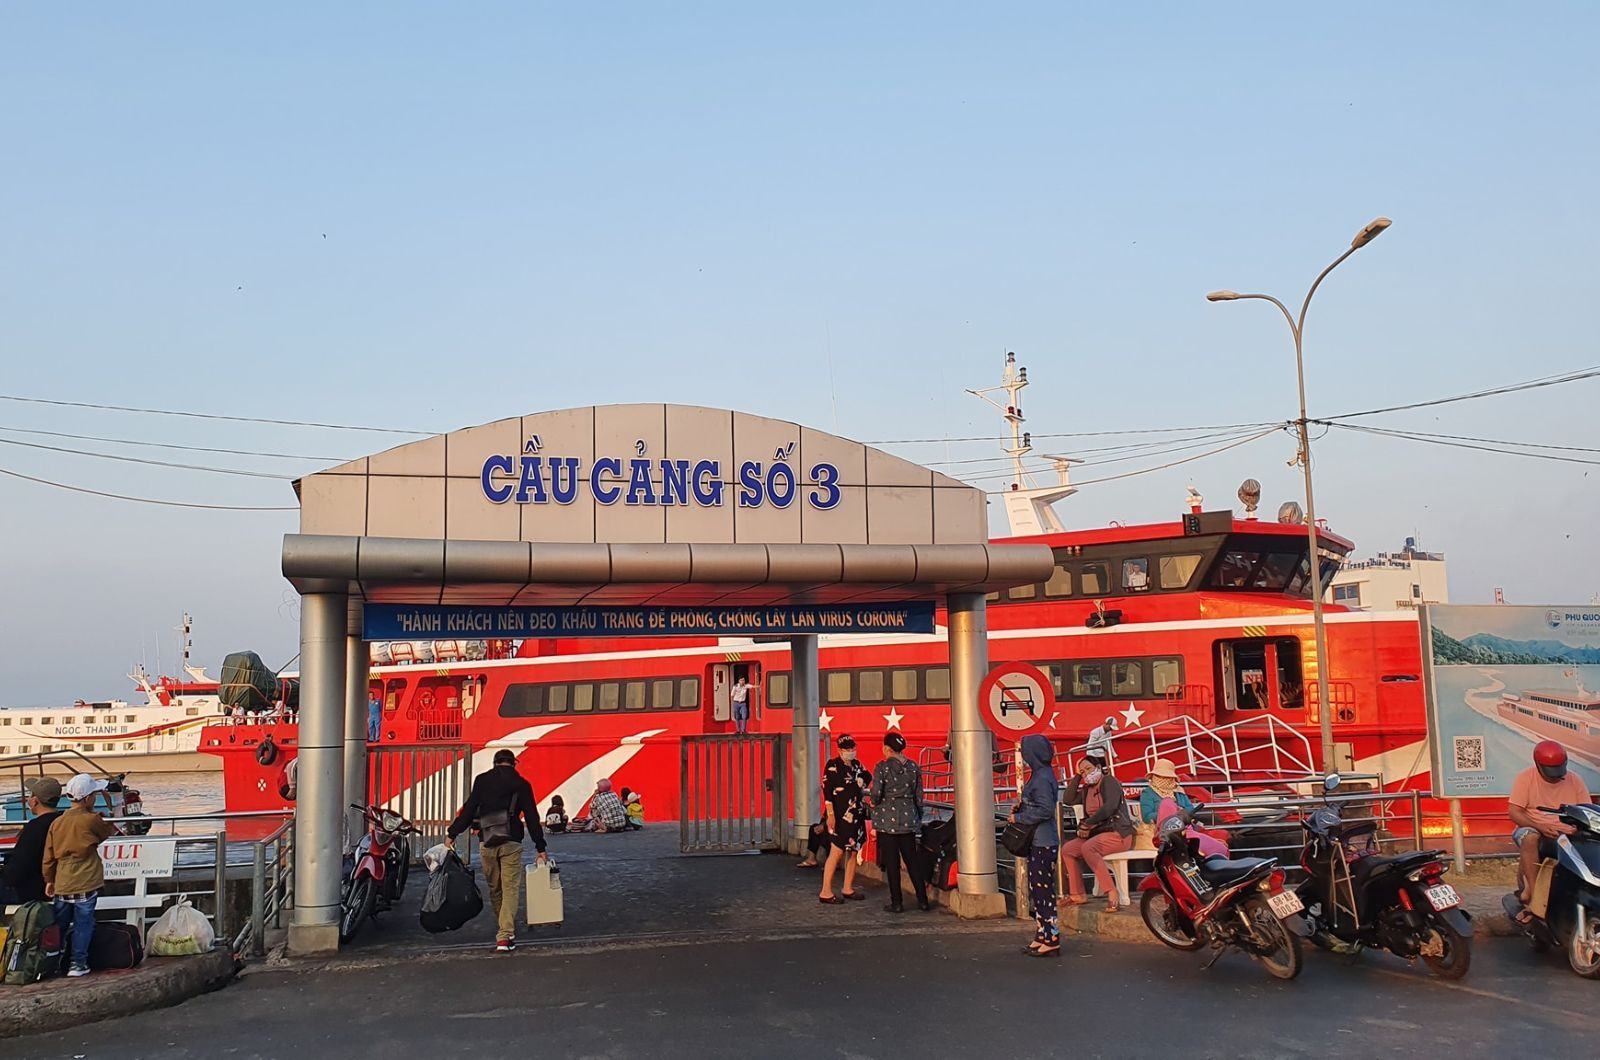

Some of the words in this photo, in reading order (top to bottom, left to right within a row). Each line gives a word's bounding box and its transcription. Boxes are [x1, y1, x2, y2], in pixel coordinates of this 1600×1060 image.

[480, 434, 580, 504] CẦU
[589, 439, 724, 507] CẢNG
[738, 441, 797, 509] SỐ
[808, 462, 842, 509] 3
[447, 610, 492, 631] KHÁCH
[498, 610, 524, 630] NÊN
[530, 612, 556, 630] ĐEO
[602, 612, 644, 629] TRANG
[719, 608, 761, 628] CHỐNG
[766, 608, 786, 627] LÂY
[792, 611, 815, 627] LAN
[820, 611, 852, 627] VIRUS
[103, 844, 142, 860] ULT
